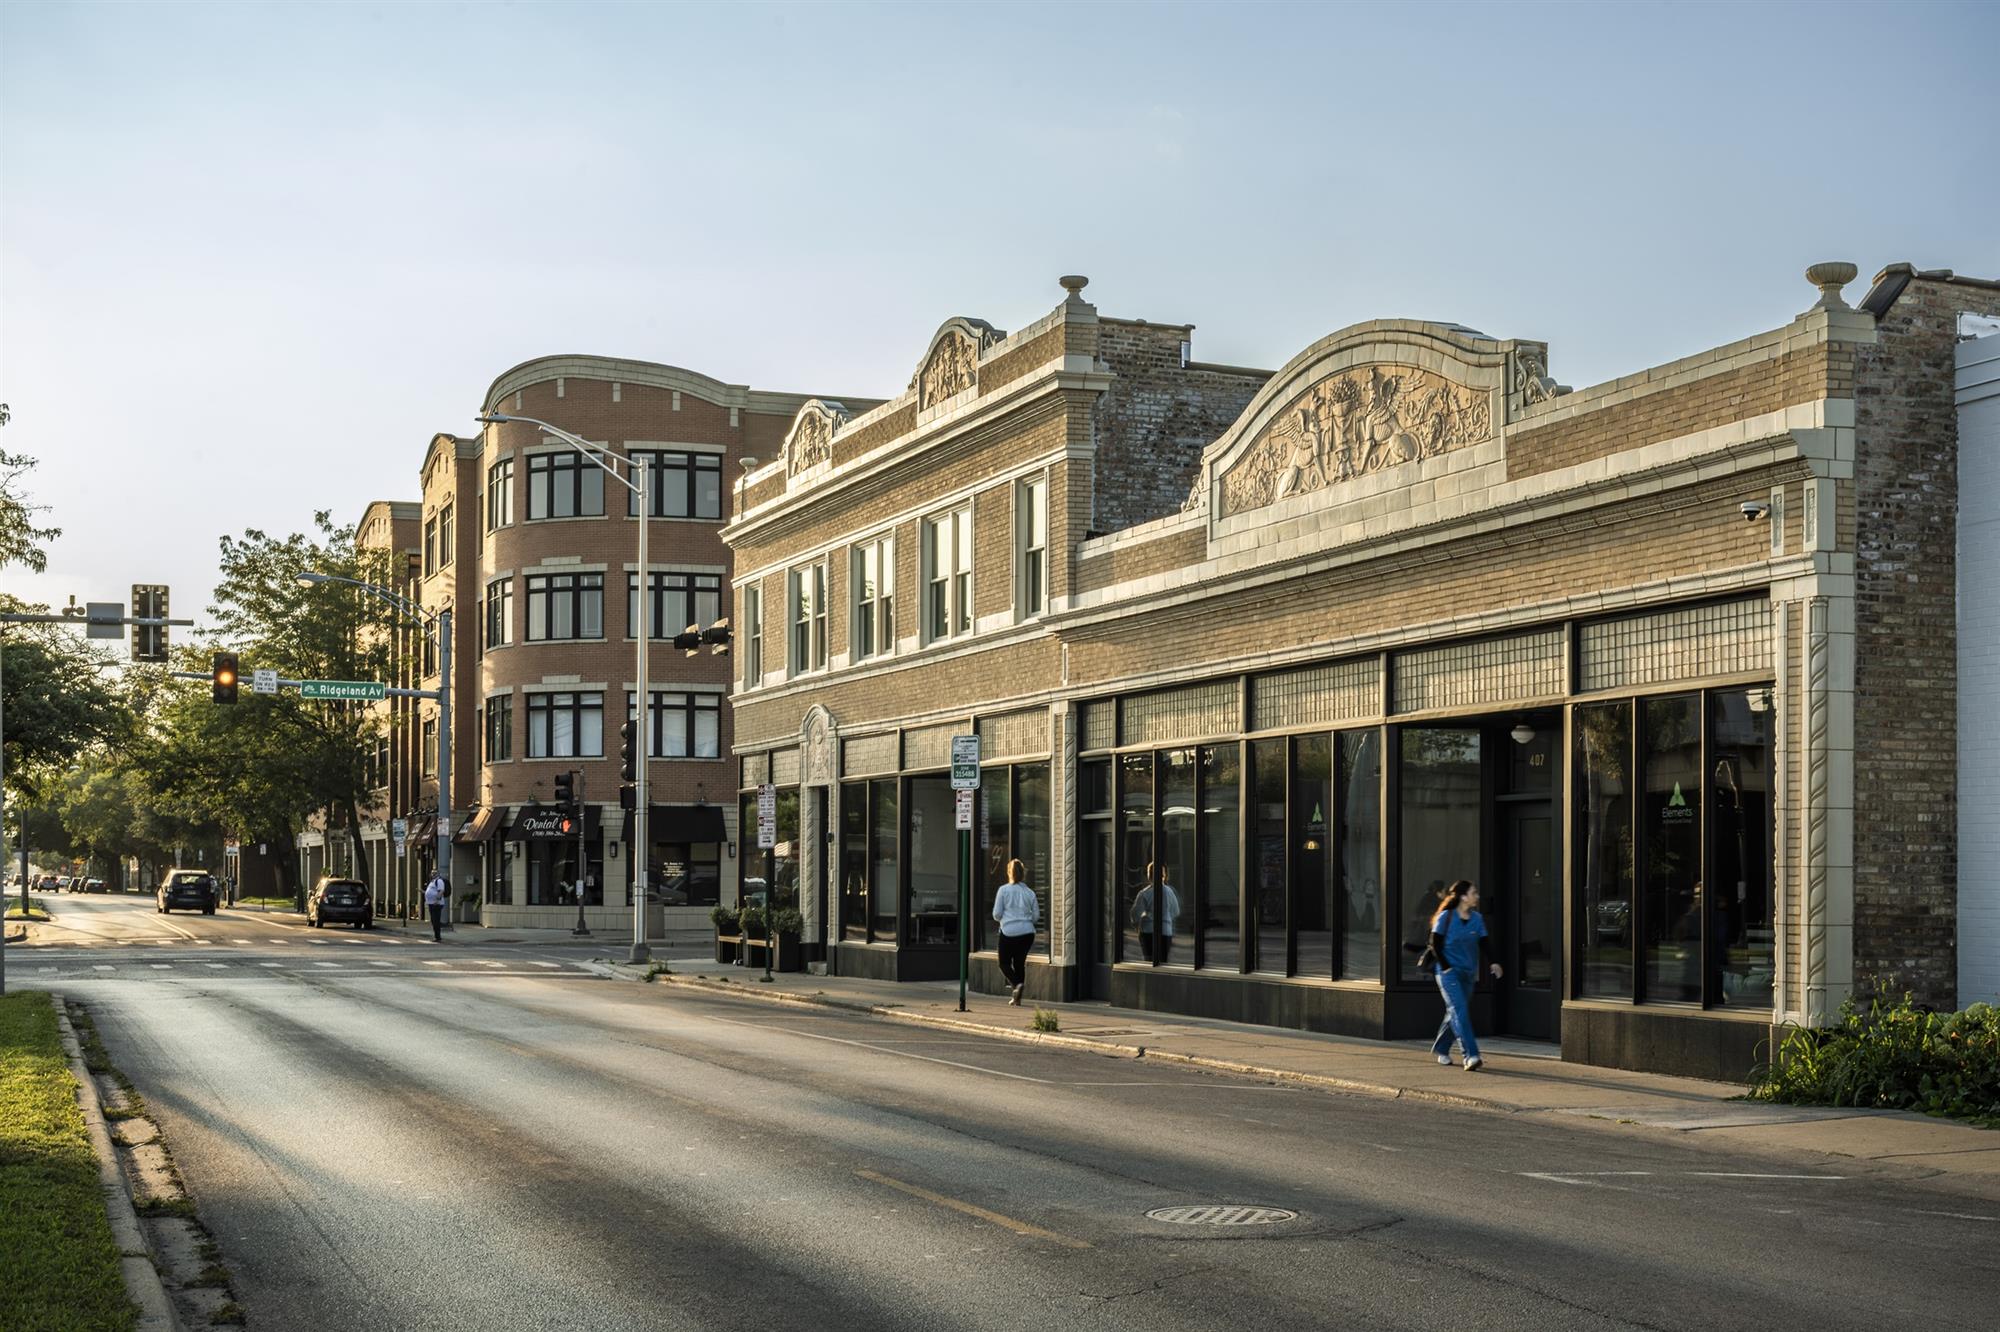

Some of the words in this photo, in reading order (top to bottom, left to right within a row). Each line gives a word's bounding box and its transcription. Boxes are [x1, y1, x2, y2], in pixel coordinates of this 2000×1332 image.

[319, 685, 367, 697] Ridgeland
[368, 686, 382, 696] Av
[1529, 753, 1545, 767] 407
[523, 817, 559, 831] Dental
